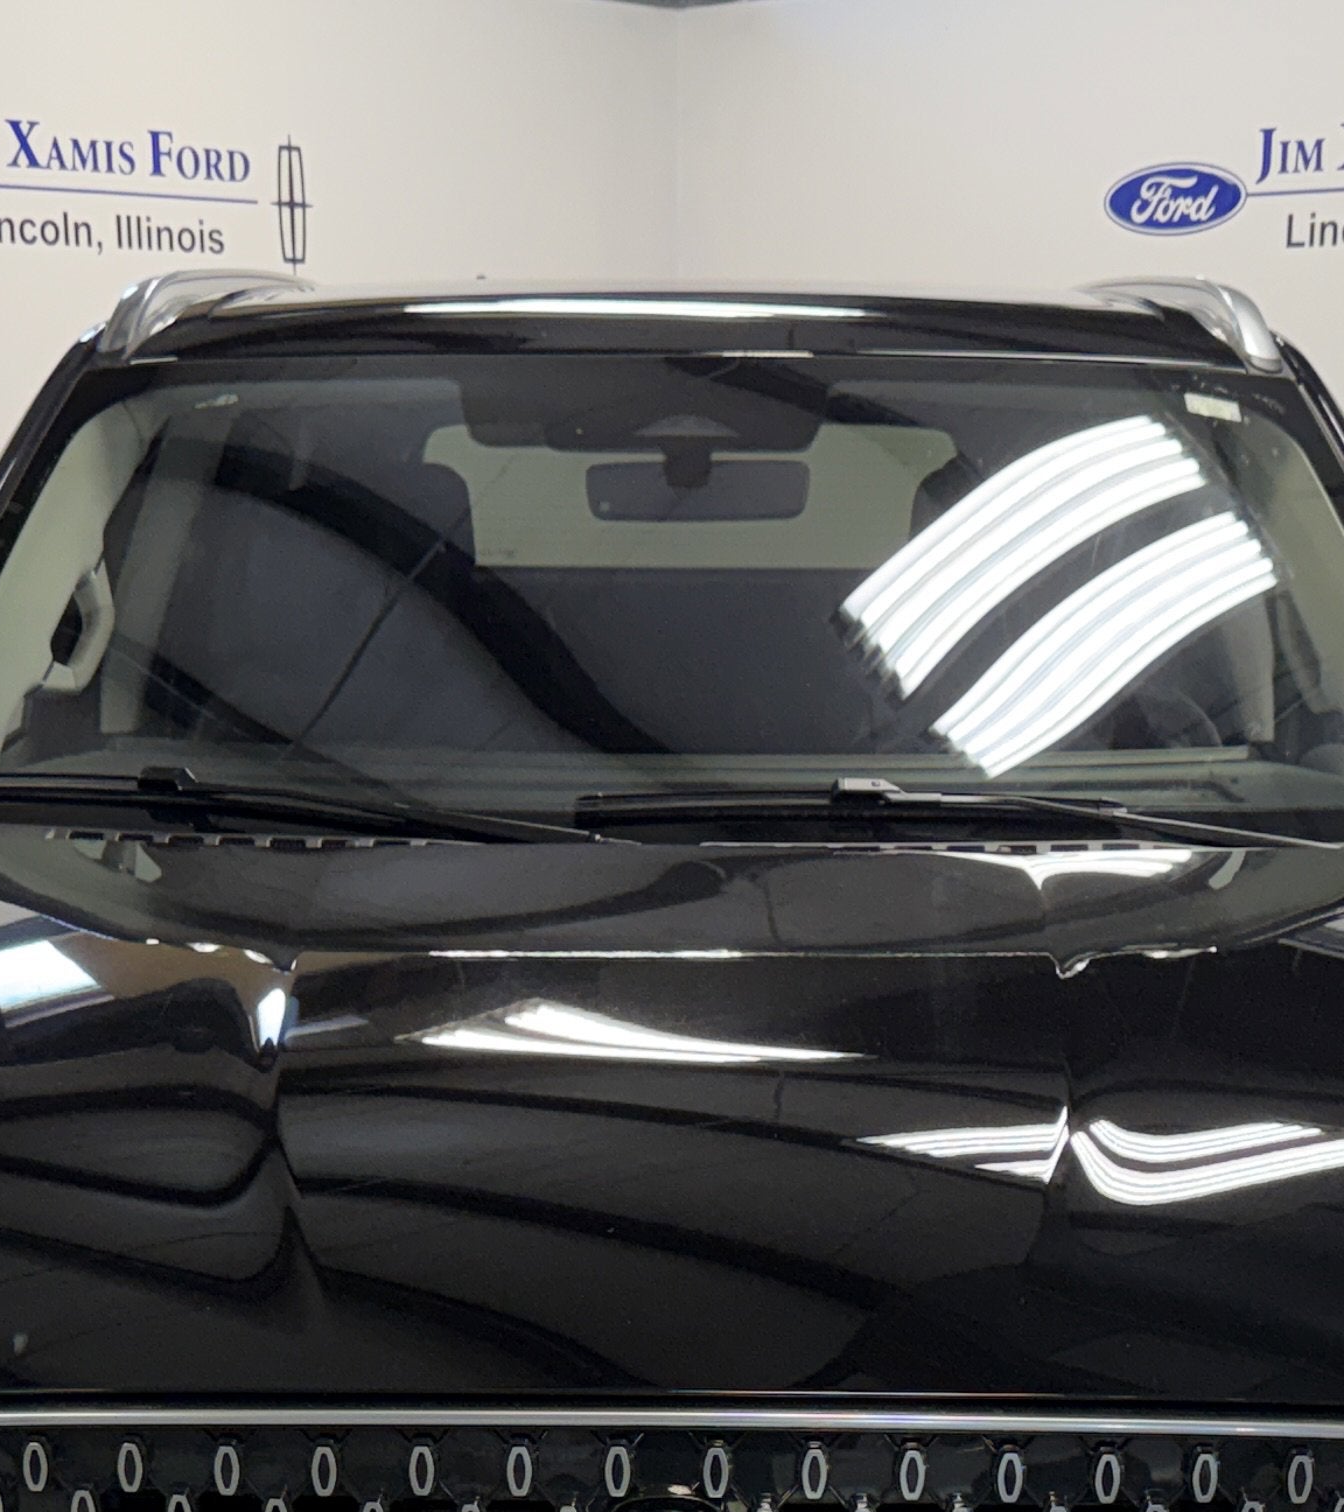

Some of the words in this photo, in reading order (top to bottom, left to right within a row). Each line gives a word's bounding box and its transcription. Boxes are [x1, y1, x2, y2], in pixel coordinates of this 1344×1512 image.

[5, 119, 136, 175] XAMIS
[146, 130, 251, 183] FORD
[1256, 127, 1324, 185] JIM
[1131, 176, 1216, 224] Ford
[116, 213, 225, 254] Illinois
